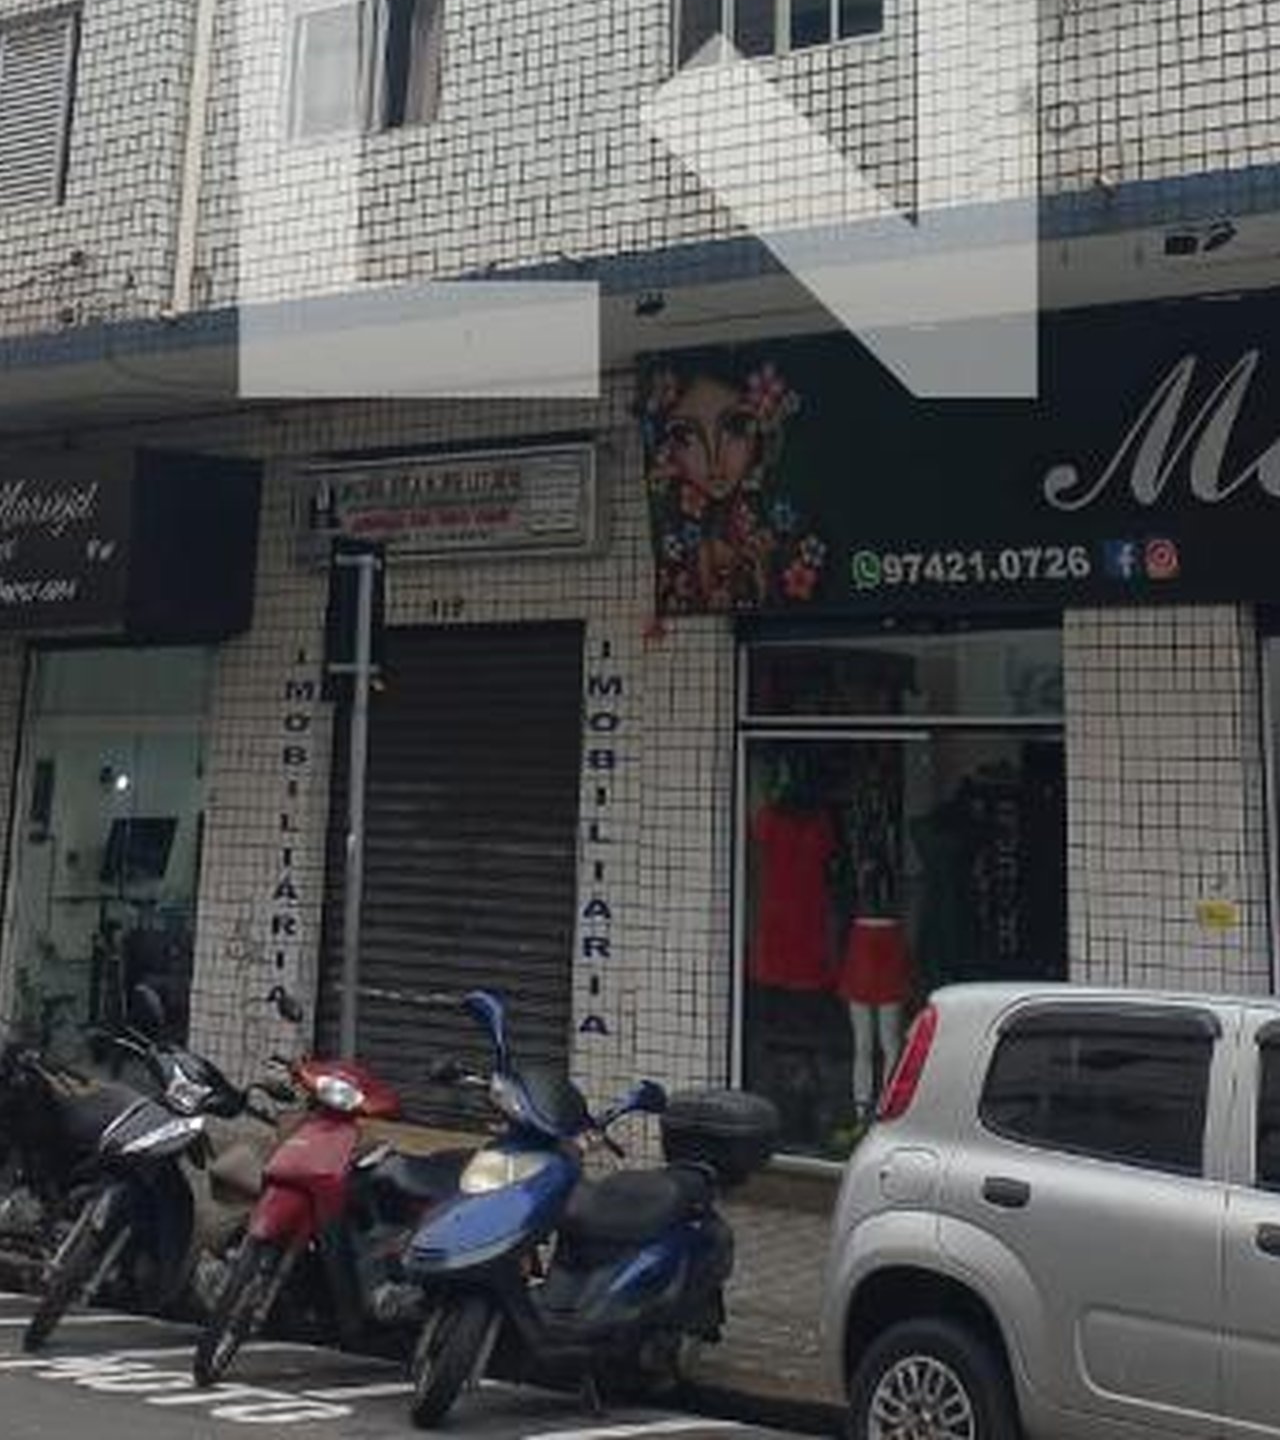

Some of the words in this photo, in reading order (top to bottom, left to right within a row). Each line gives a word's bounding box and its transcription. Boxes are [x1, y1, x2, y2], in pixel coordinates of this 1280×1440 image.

[883, 546, 1090, 584] 97421.0726
[267, 650, 314, 1007] IMOBILIARIA
[579, 640, 622, 1035] IMOBILIARIA
